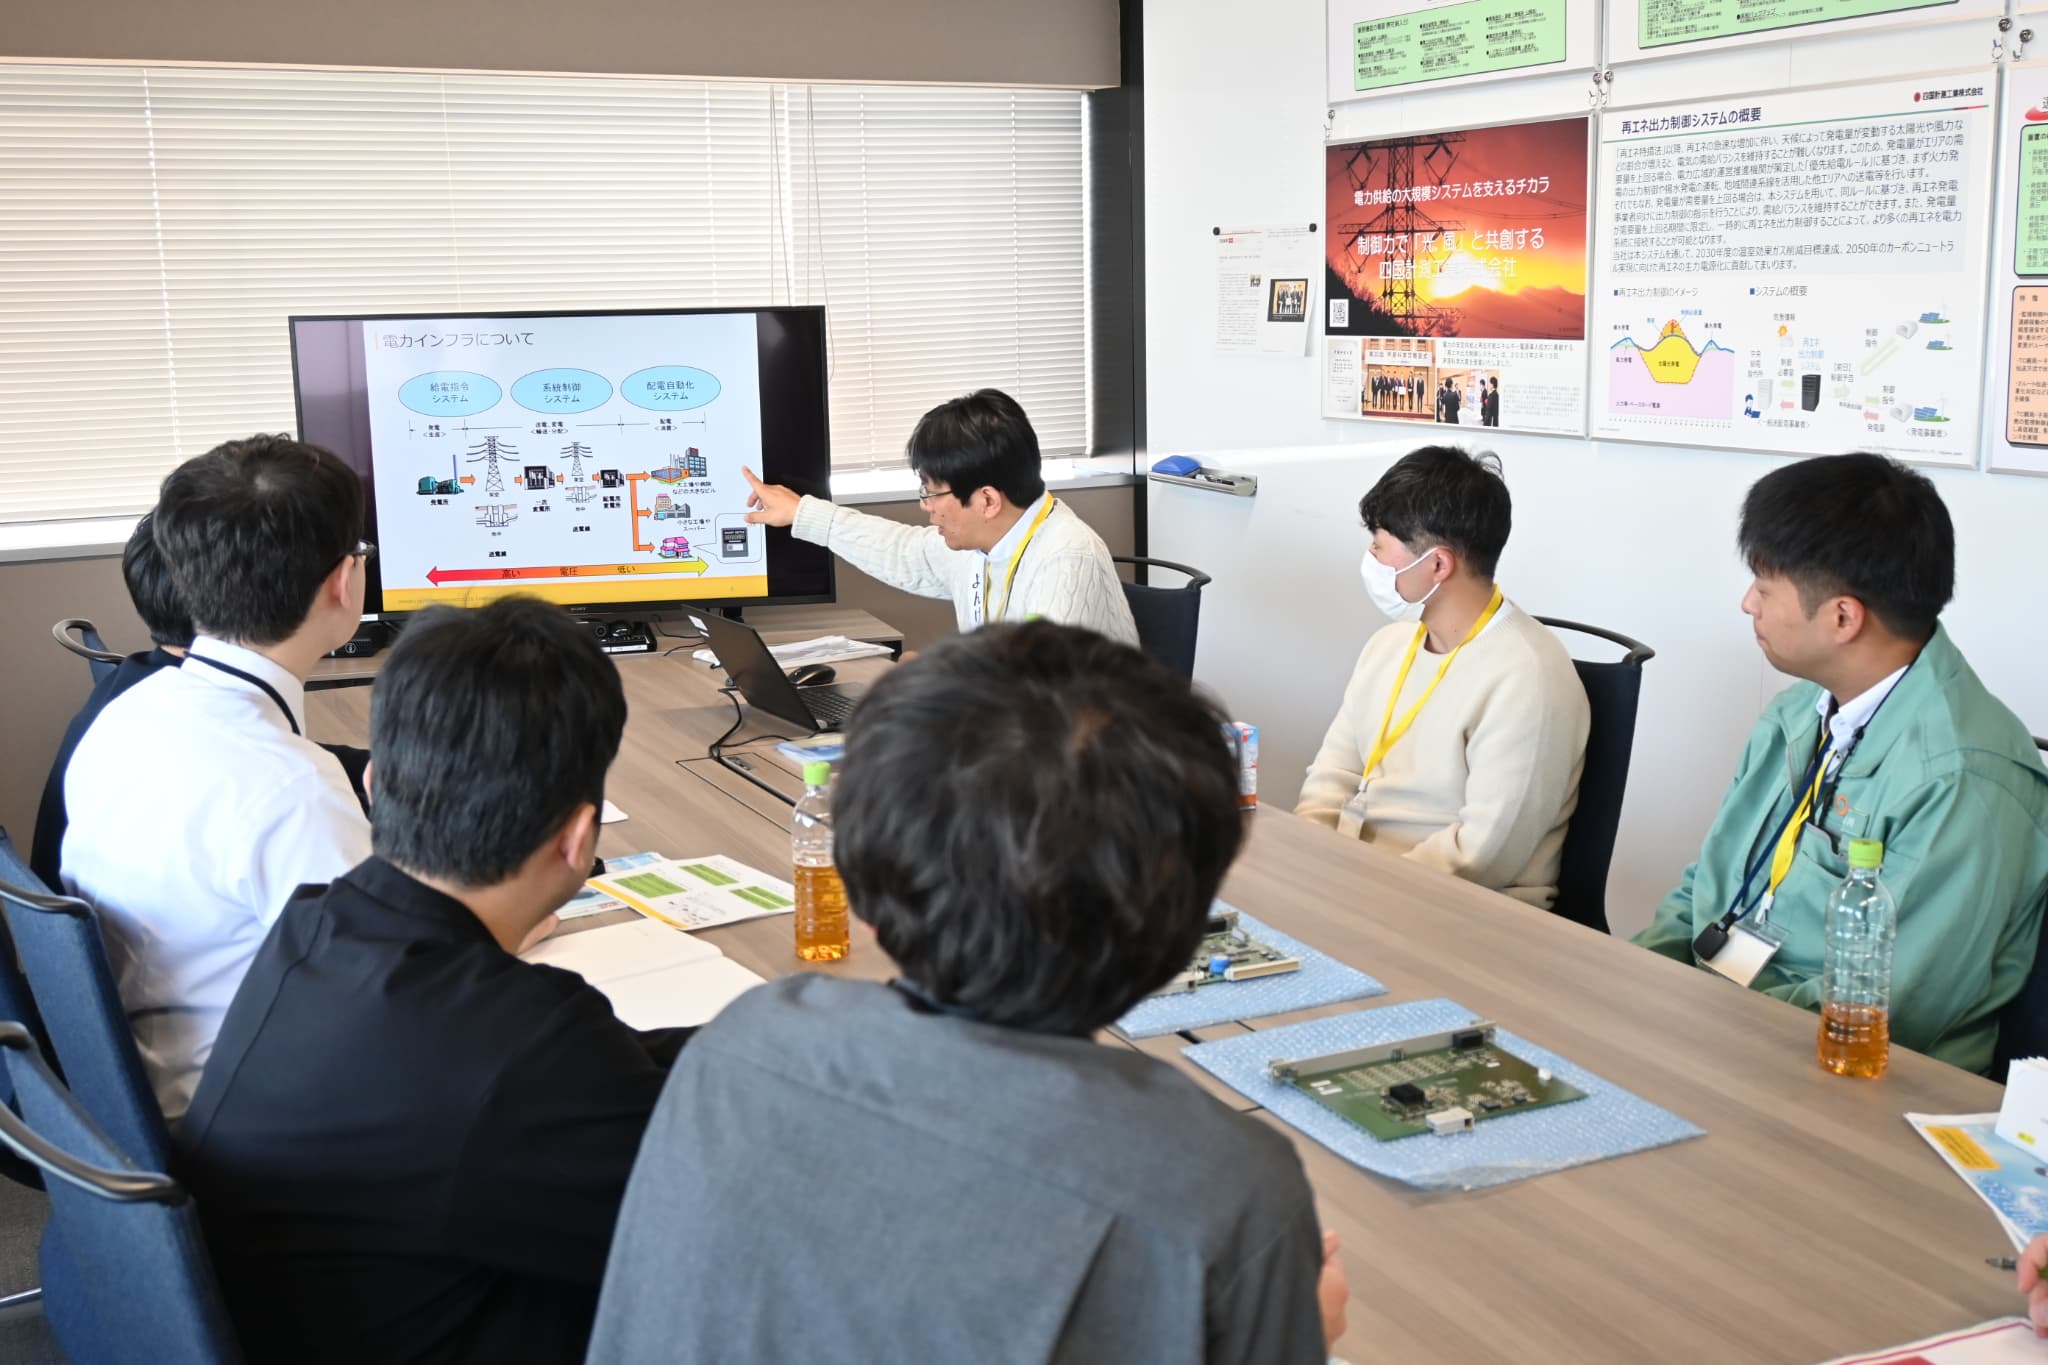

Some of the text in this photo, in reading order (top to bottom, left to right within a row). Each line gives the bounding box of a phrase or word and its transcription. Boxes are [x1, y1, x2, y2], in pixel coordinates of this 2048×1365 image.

[1621, 107, 1762, 135] 再エネ出力制御システムの概要
[1354, 176, 1550, 206] 電力供給の大規模システムを支えるチカラ
[382, 332, 534, 349] 電力インフラについて
[430, 382, 470, 392] 給電指令
[543, 382, 582, 393] 系統制御
[646, 380, 695, 391] 配電自動化
[432, 394, 469, 404] システム
[544, 393, 580, 404] システム
[653, 391, 689, 401] システム
[502, 569, 521, 579] 高い
[559, 567, 578, 577] 電圧
